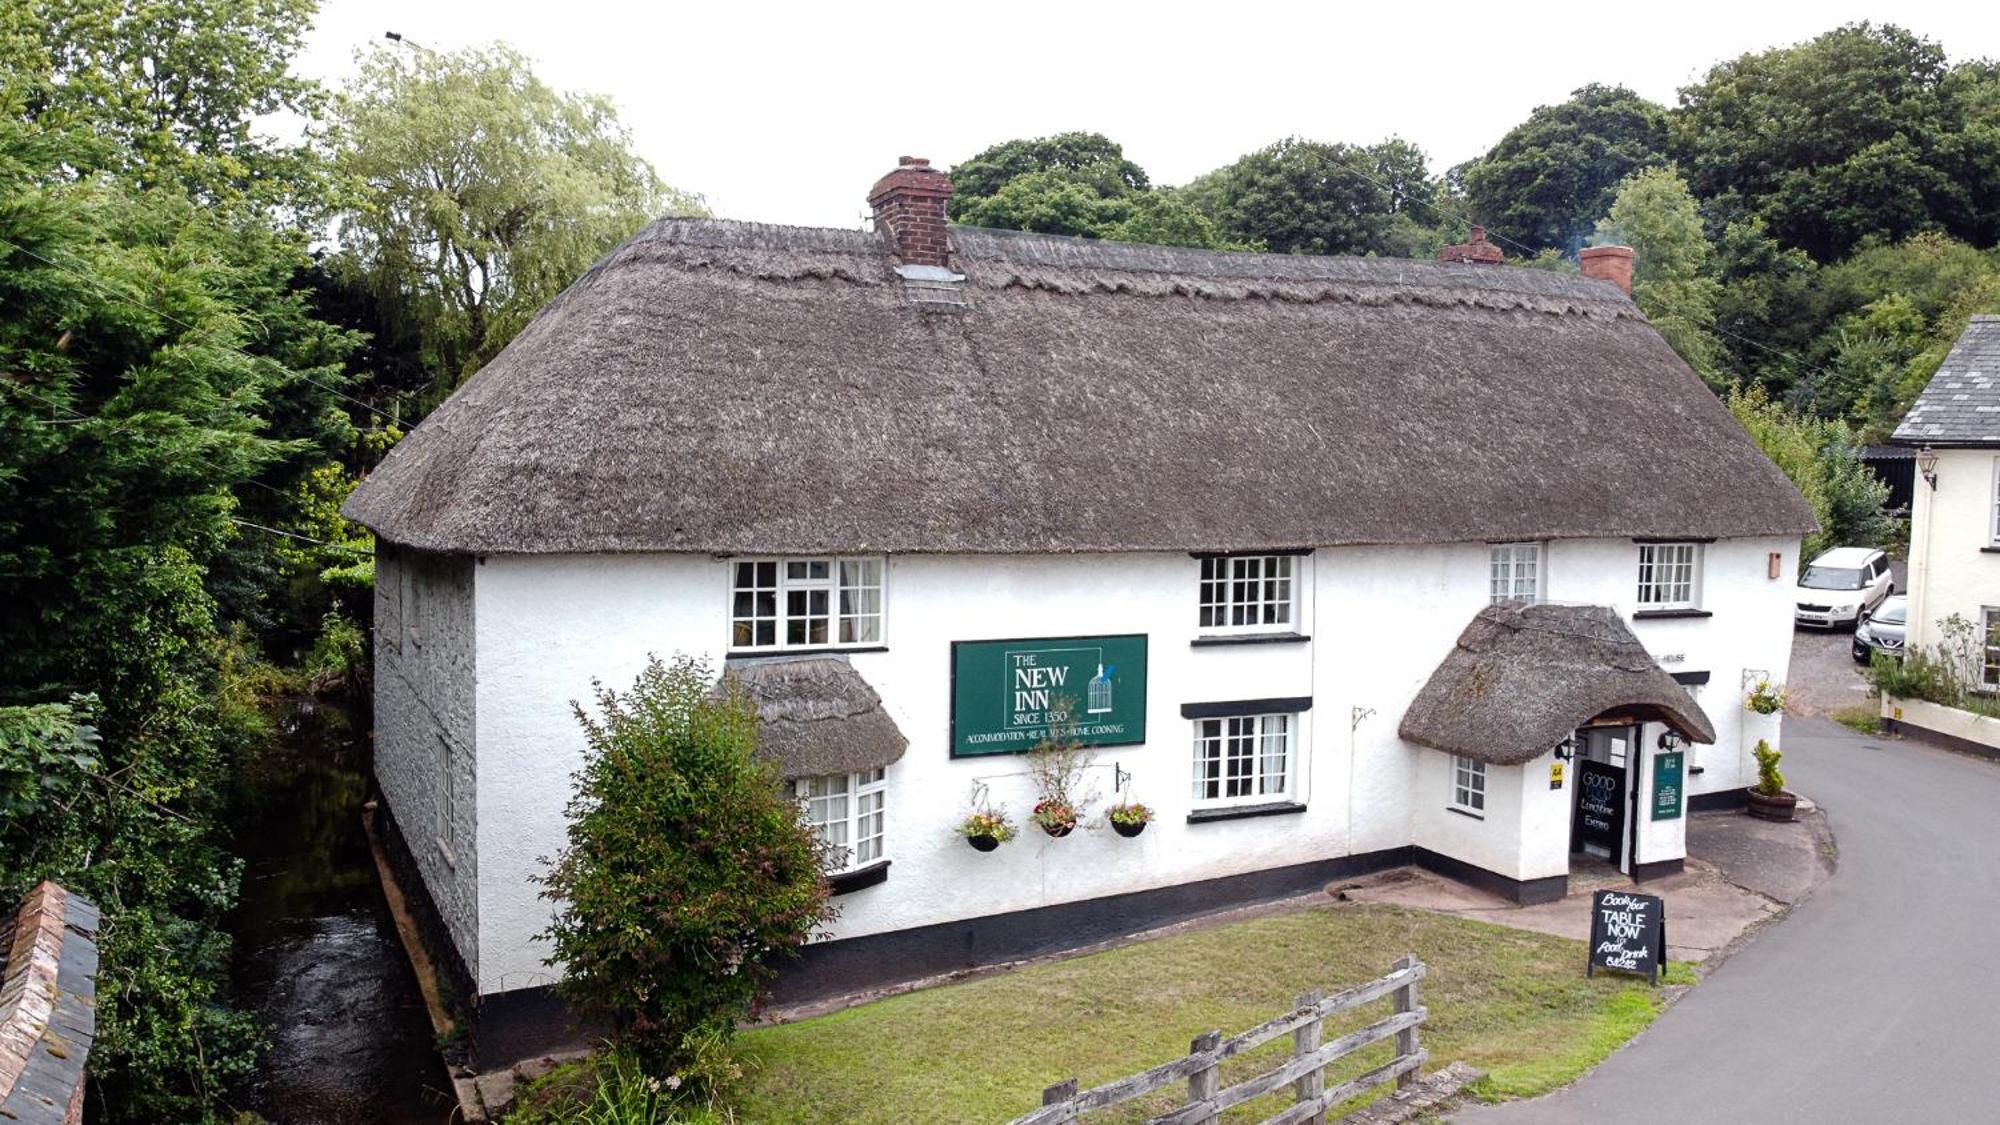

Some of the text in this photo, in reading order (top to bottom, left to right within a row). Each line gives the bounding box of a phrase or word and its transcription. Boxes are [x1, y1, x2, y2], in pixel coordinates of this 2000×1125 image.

[1013, 655, 1036, 667] THE
[1015, 666, 1069, 689] NEW
[1015, 690, 1050, 711] INN
[1013, 711, 1068, 725] SINCE 1350
[1583, 771, 1616, 791] GOOD
[1601, 893, 1649, 912] Book Your
[1601, 910, 1646, 928] TABLE
[1607, 923, 1640, 939] NOW
